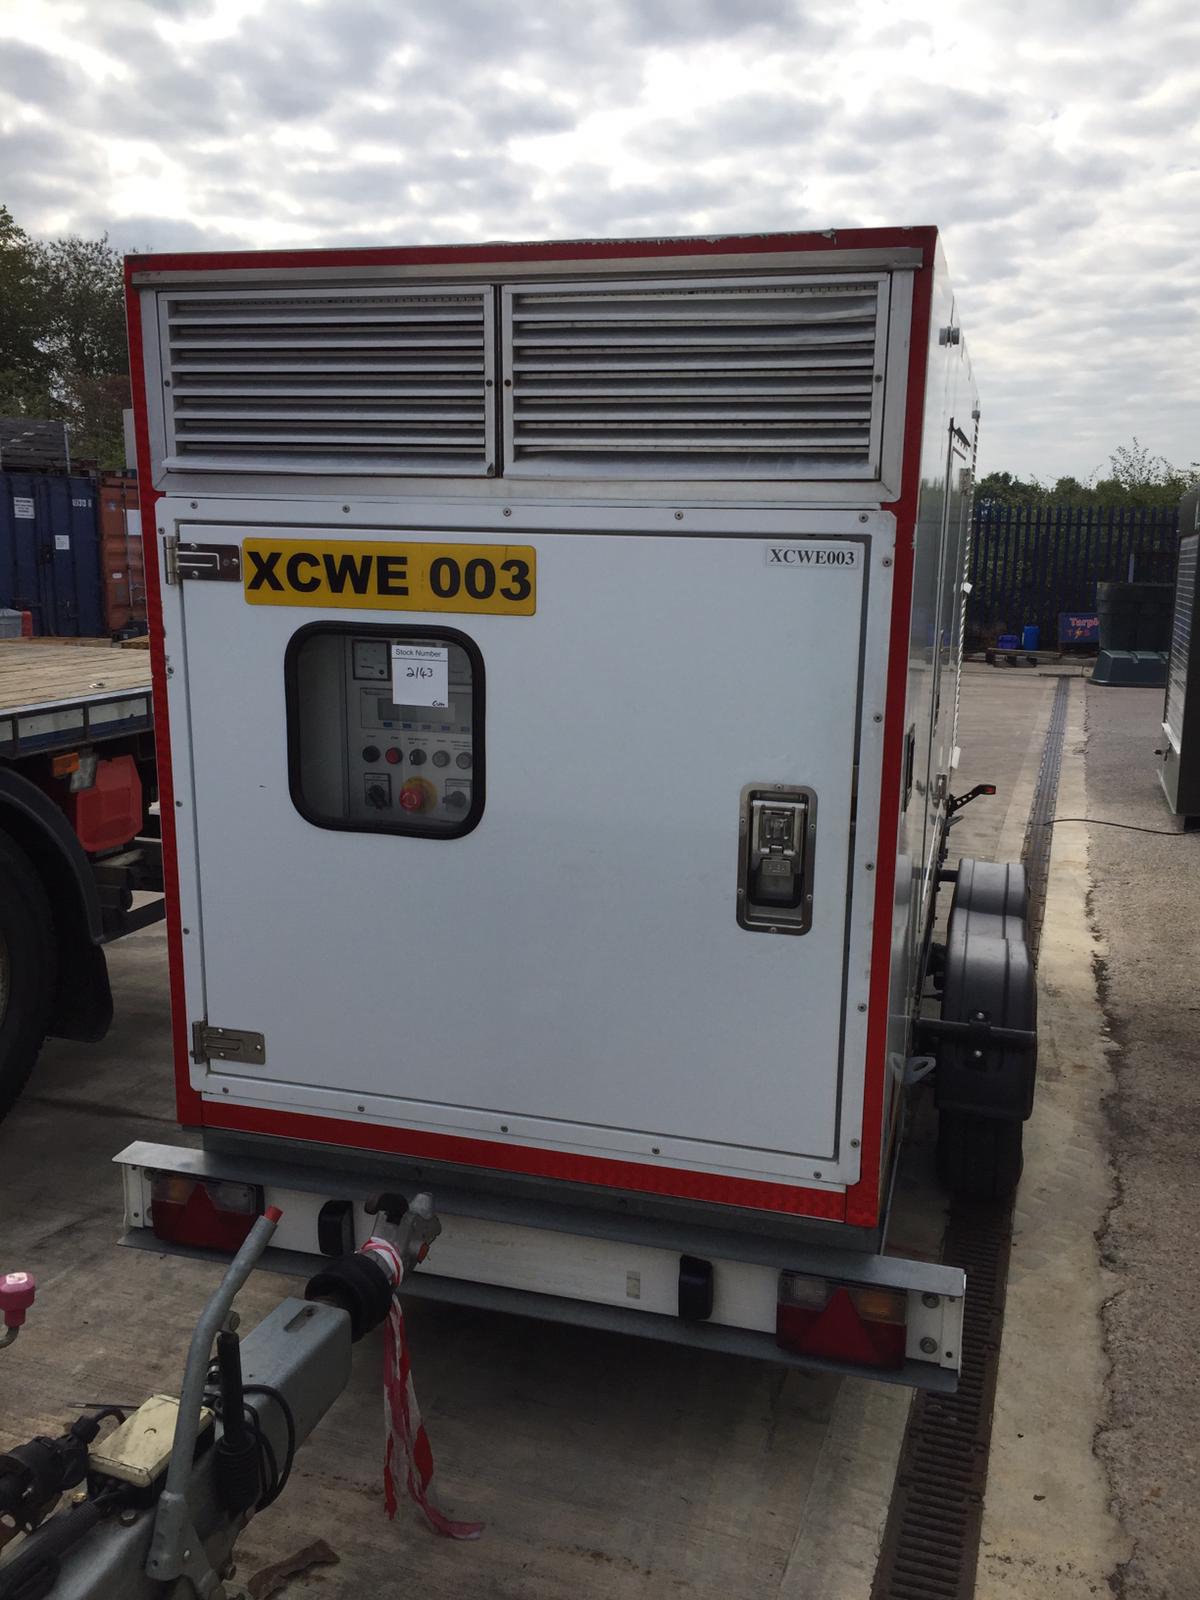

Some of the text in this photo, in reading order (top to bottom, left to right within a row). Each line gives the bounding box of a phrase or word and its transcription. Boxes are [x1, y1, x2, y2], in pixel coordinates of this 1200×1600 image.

[769, 548, 855, 565] XCWE003
[247, 551, 532, 601] XCWE 003
[395, 648, 441, 658] Stock Number
